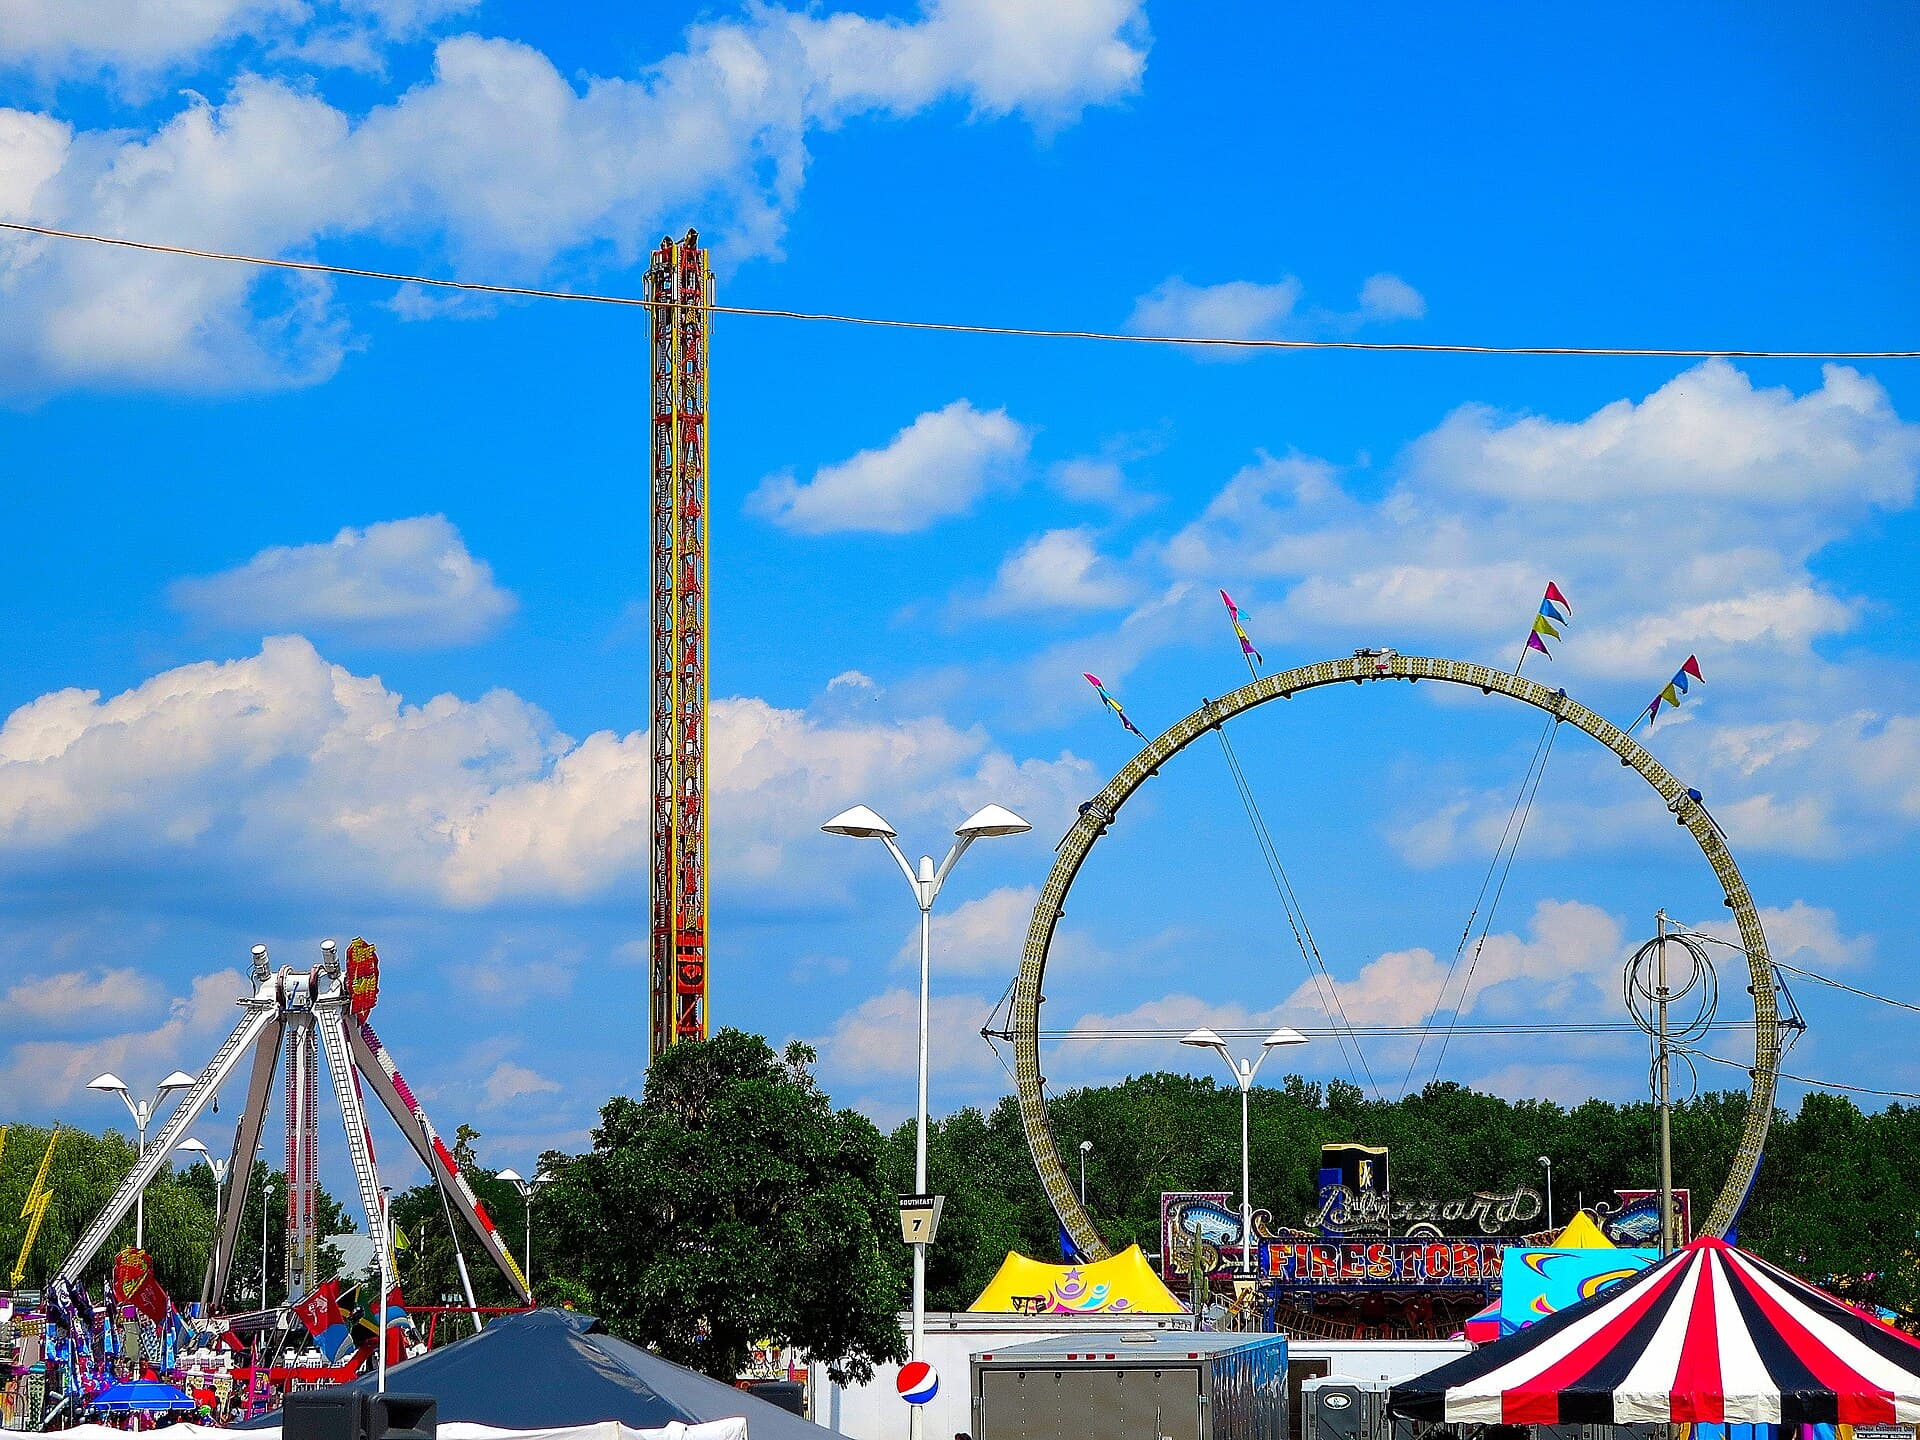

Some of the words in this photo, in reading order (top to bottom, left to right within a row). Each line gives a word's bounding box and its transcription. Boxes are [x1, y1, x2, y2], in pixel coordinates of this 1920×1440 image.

[900, 1198, 933, 1206] SOUTHEAST
[1304, 1183, 1543, 1233] Blizzard
[912, 1218, 923, 1232] 7
[1267, 1243, 1504, 1279] FIRESTORM
